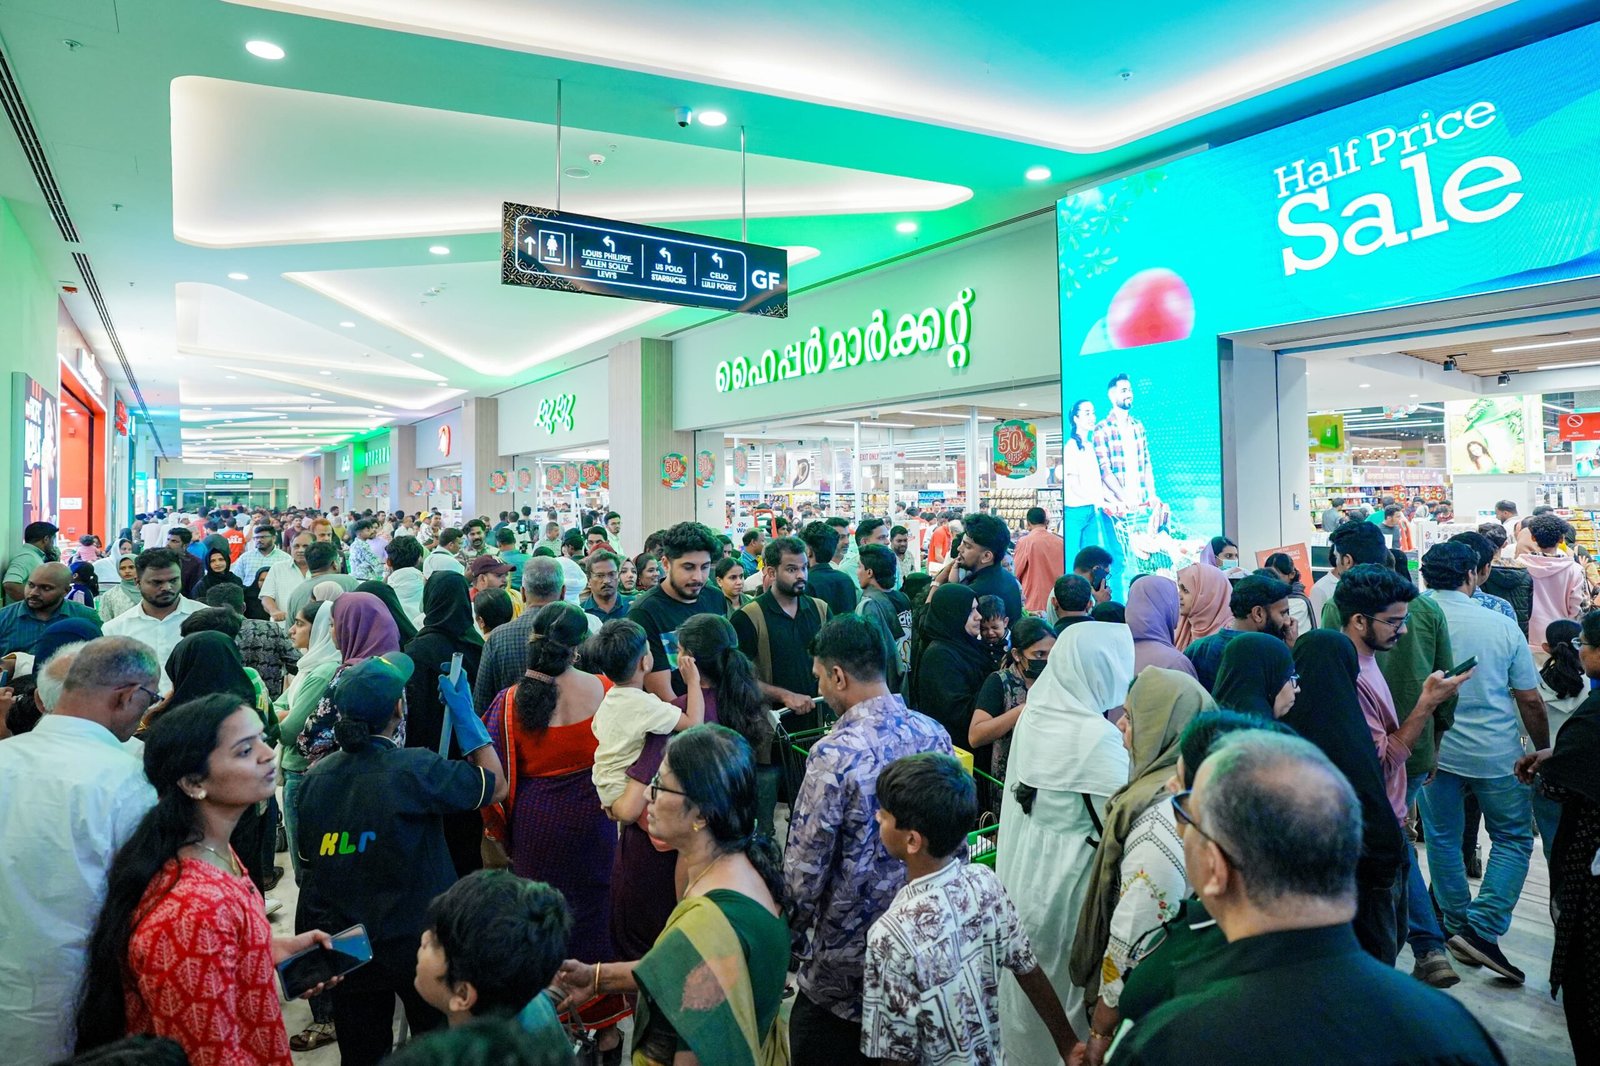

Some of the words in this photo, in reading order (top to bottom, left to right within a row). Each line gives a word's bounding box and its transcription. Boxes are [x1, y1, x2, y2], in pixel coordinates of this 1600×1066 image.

[1273, 138, 1361, 198] Half
[1366, 101, 1496, 166] Price
[1277, 152, 1525, 277] Sale
[582, 248, 603, 258] LOUIS
[604, 252, 632, 262] PHILIPPE
[585, 259, 607, 268] ALLEN
[608, 262, 629, 271] SOLLY
[655, 263, 664, 271] US
[664, 264, 683, 273] POLO
[597, 270, 617, 279] LEVI'S
[651, 273, 687, 285] STARBUCKS
[709, 271, 729, 281] CELIO
[751, 269, 781, 290] GF
[701, 280, 716, 289] LULU
[716, 282, 737, 291] FOREX
[859, 453, 868, 461] EXIT
[869, 453, 879, 461] ONLY
